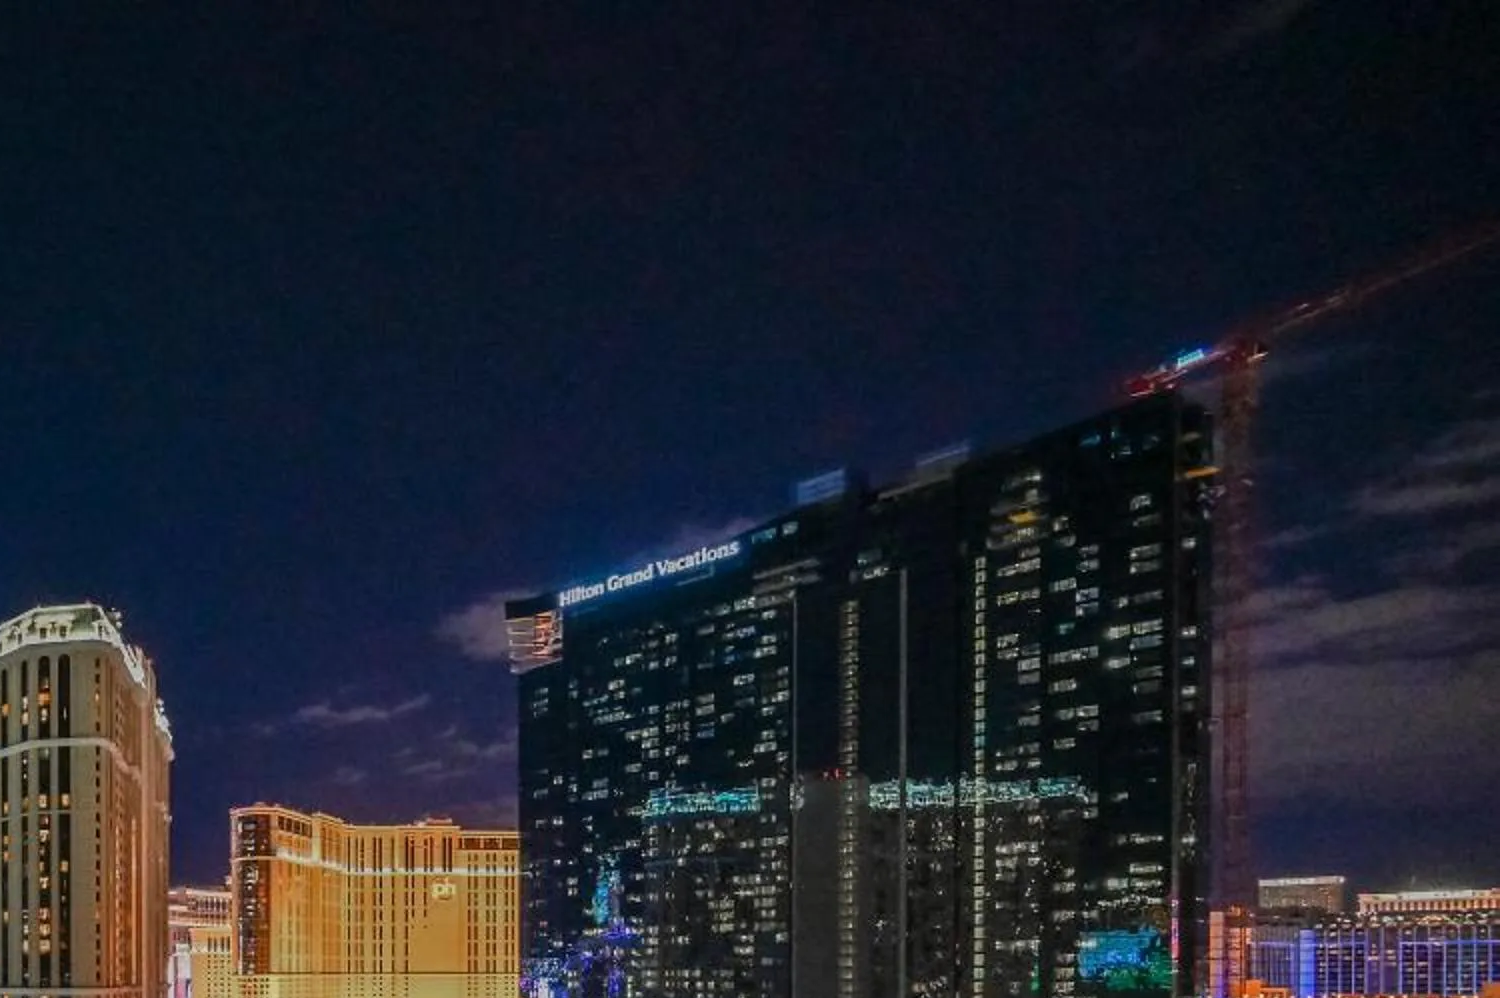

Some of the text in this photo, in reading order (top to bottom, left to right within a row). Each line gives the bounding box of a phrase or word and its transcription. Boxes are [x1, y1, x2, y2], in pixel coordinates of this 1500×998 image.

[558, 541, 740, 607] Hilton Grand Vacations
